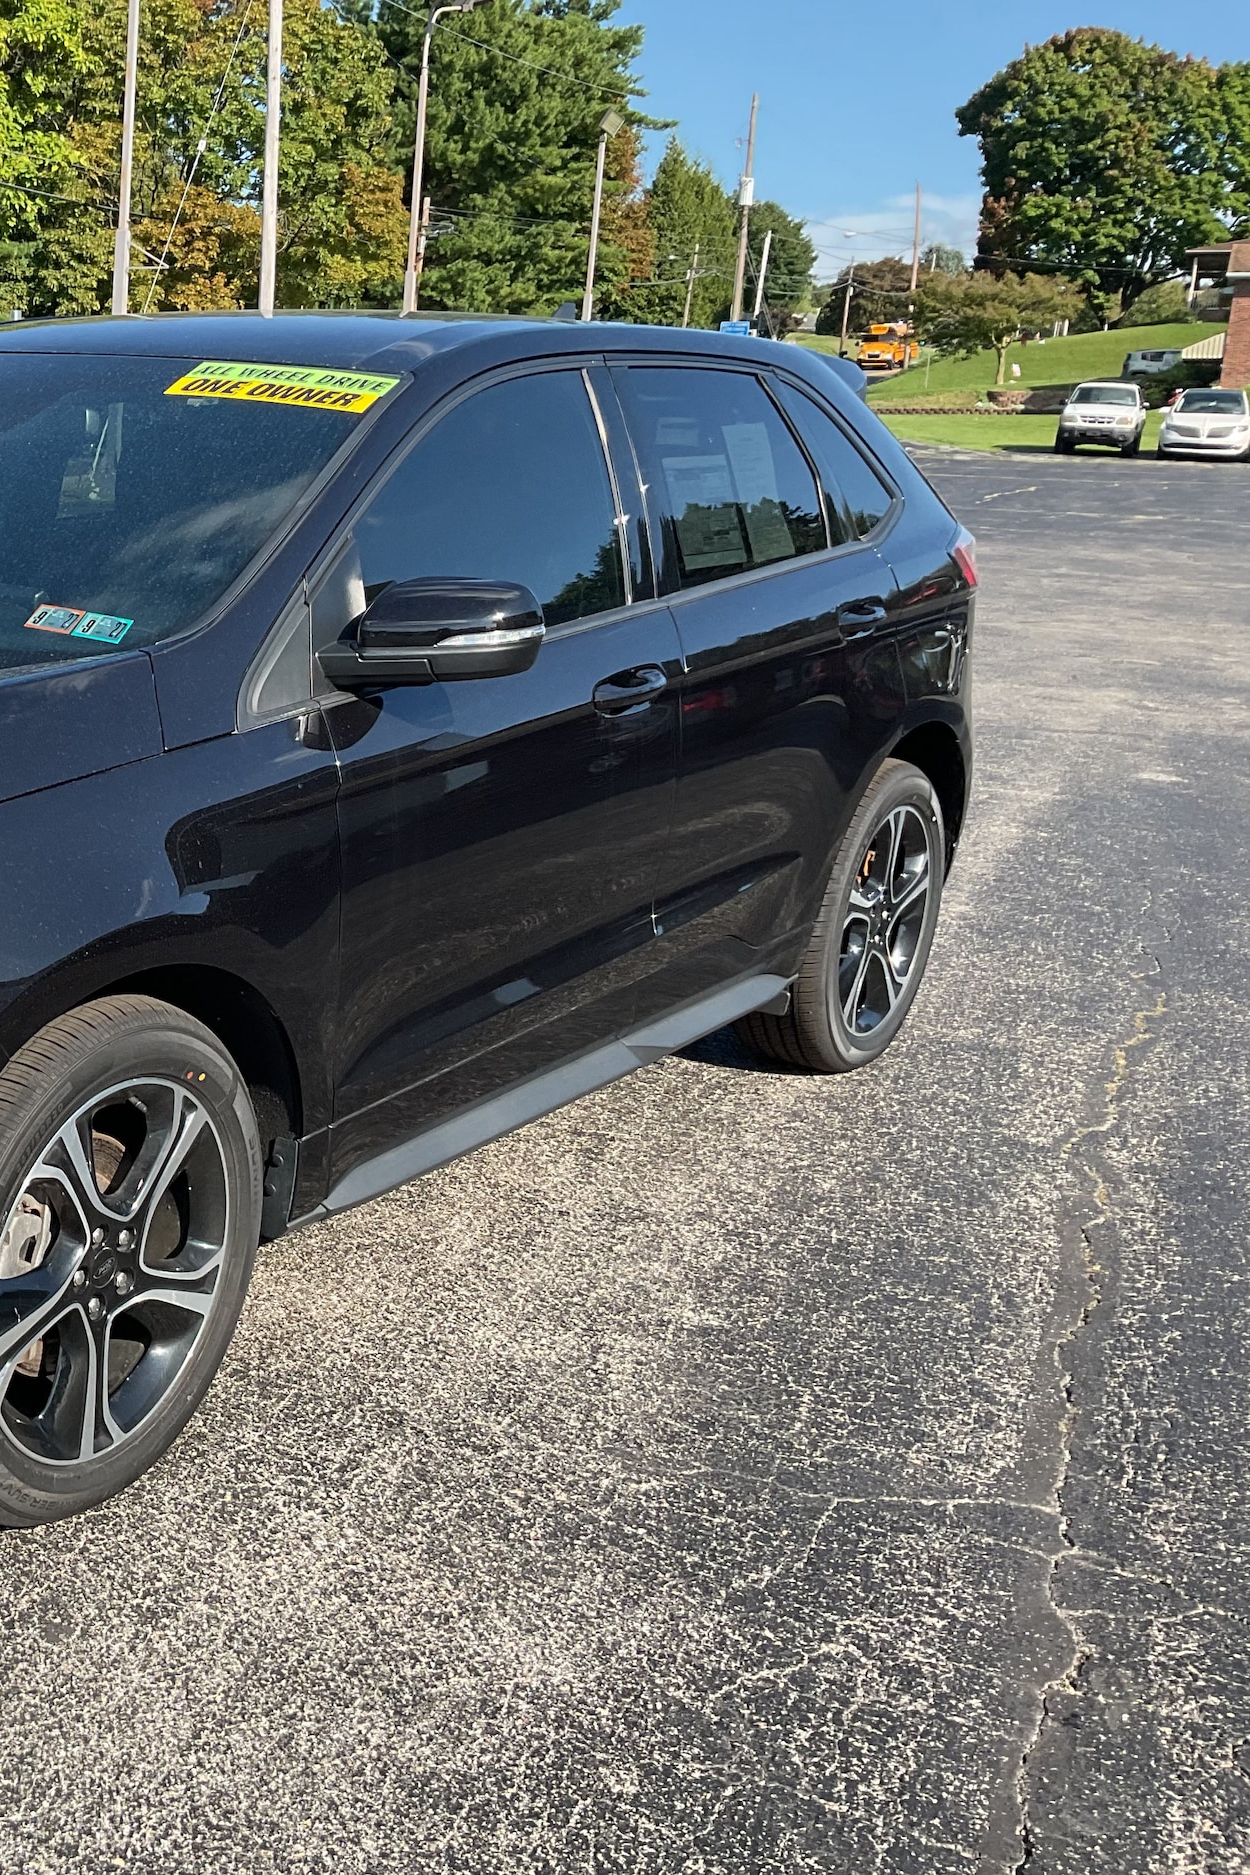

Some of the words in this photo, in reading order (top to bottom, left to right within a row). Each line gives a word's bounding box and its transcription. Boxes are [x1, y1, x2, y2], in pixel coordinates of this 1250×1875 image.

[181, 378, 250, 395] ONE
[250, 383, 362, 407] OWNER
[193, 366, 232, 376] ALL
[240, 367, 313, 383] WHEEL
[318, 373, 392, 393] DRIVE
